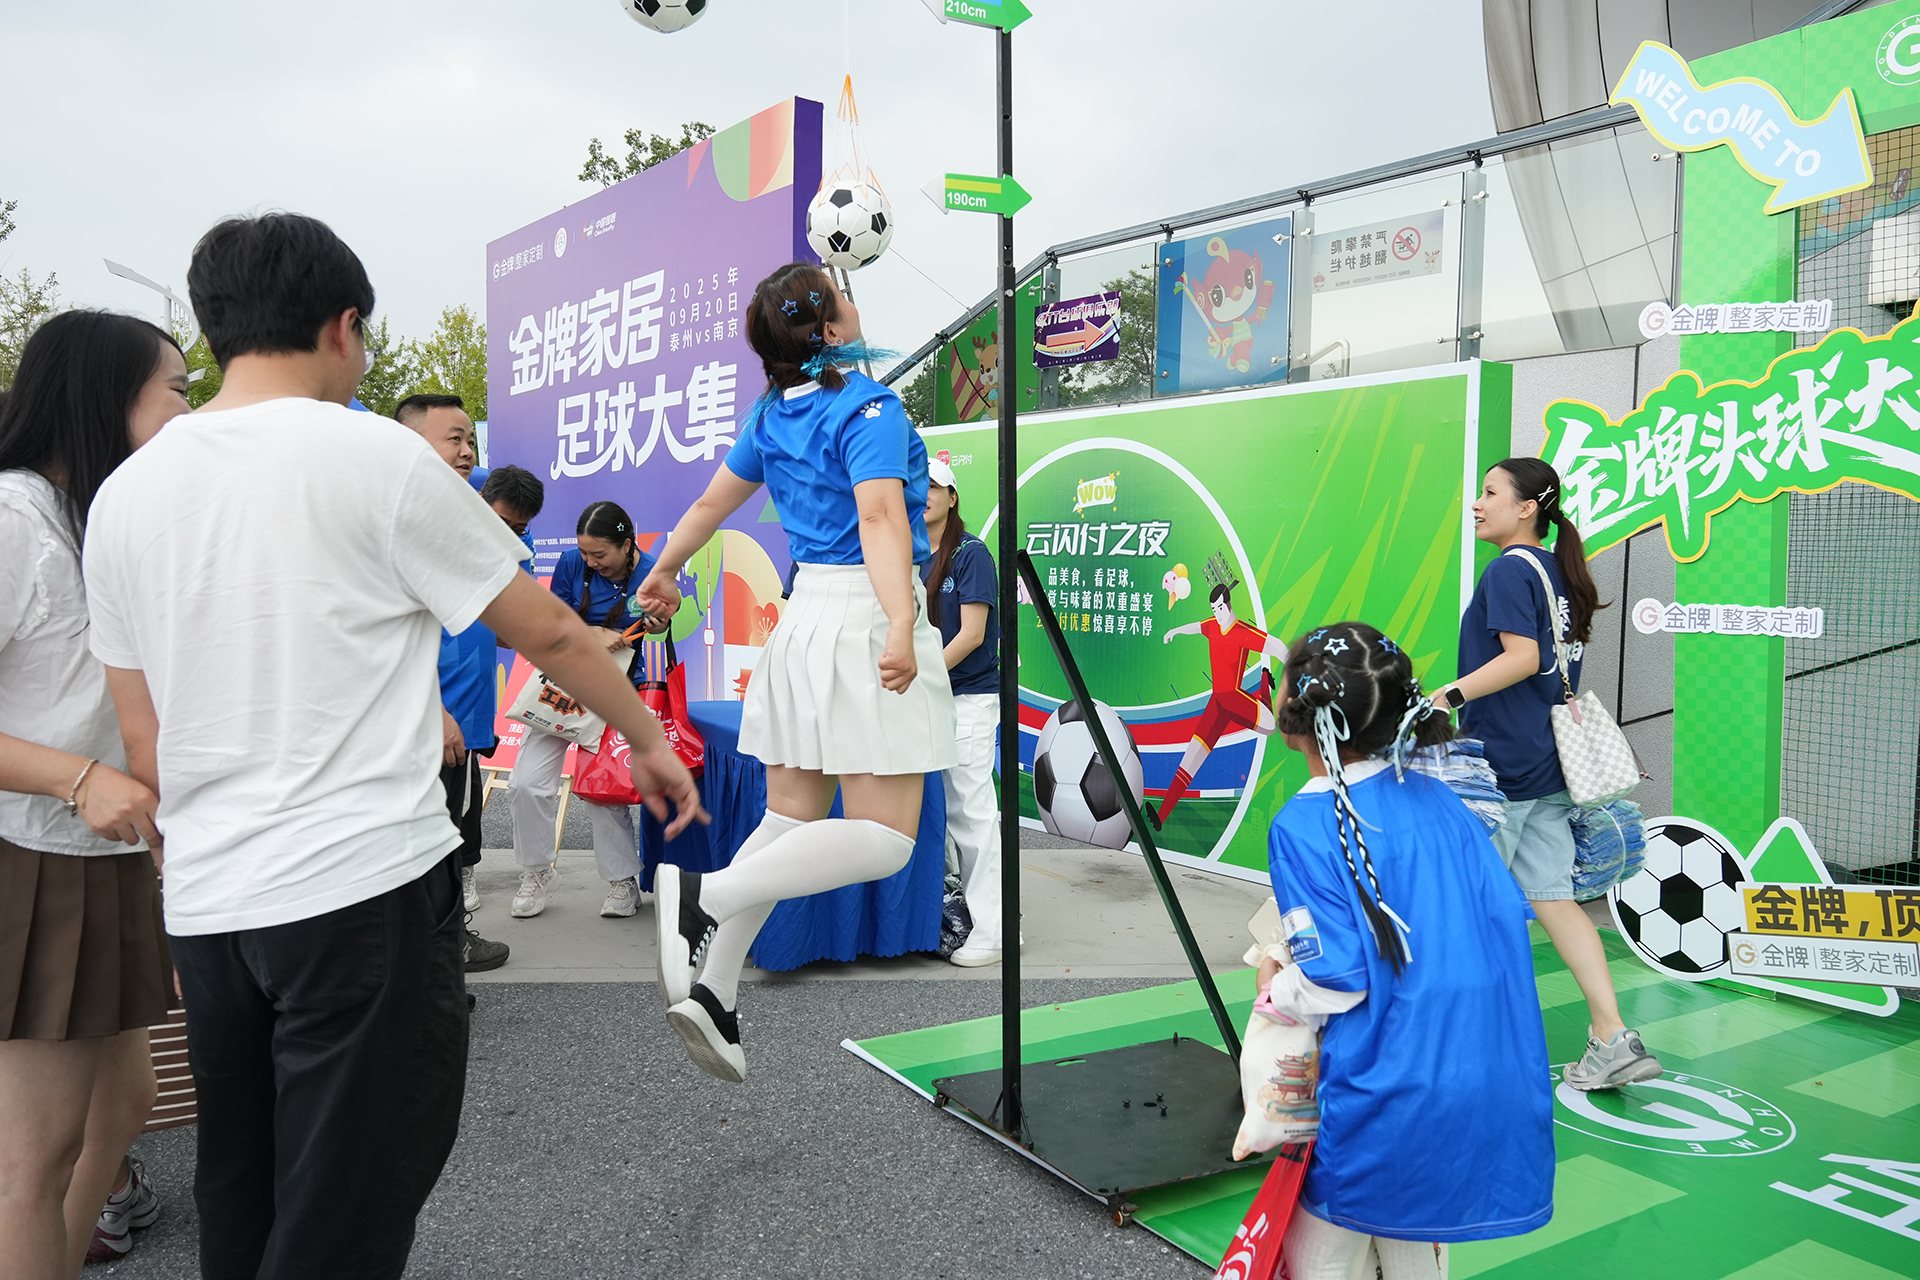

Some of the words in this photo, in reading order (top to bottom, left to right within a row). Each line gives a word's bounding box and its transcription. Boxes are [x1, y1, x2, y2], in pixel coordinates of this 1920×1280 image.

[946, 0, 986, 19] 210cm
[1635, 68, 1781, 151] WELCOME
[1774, 138, 1821, 177] TO
[947, 192, 987, 208] 190cm
[670, 267, 738, 303] 2025年
[670, 292, 738, 327] 09月20日
[509, 269, 664, 396] 金牌家居
[550, 361, 738, 480] 足球大集
[1550, 337, 1920, 550] 金牌头球大
[1026, 521, 1171, 556] 云闪付之夜
[1044, 589, 1153, 612] 觉与味蕾的双重盛宴
